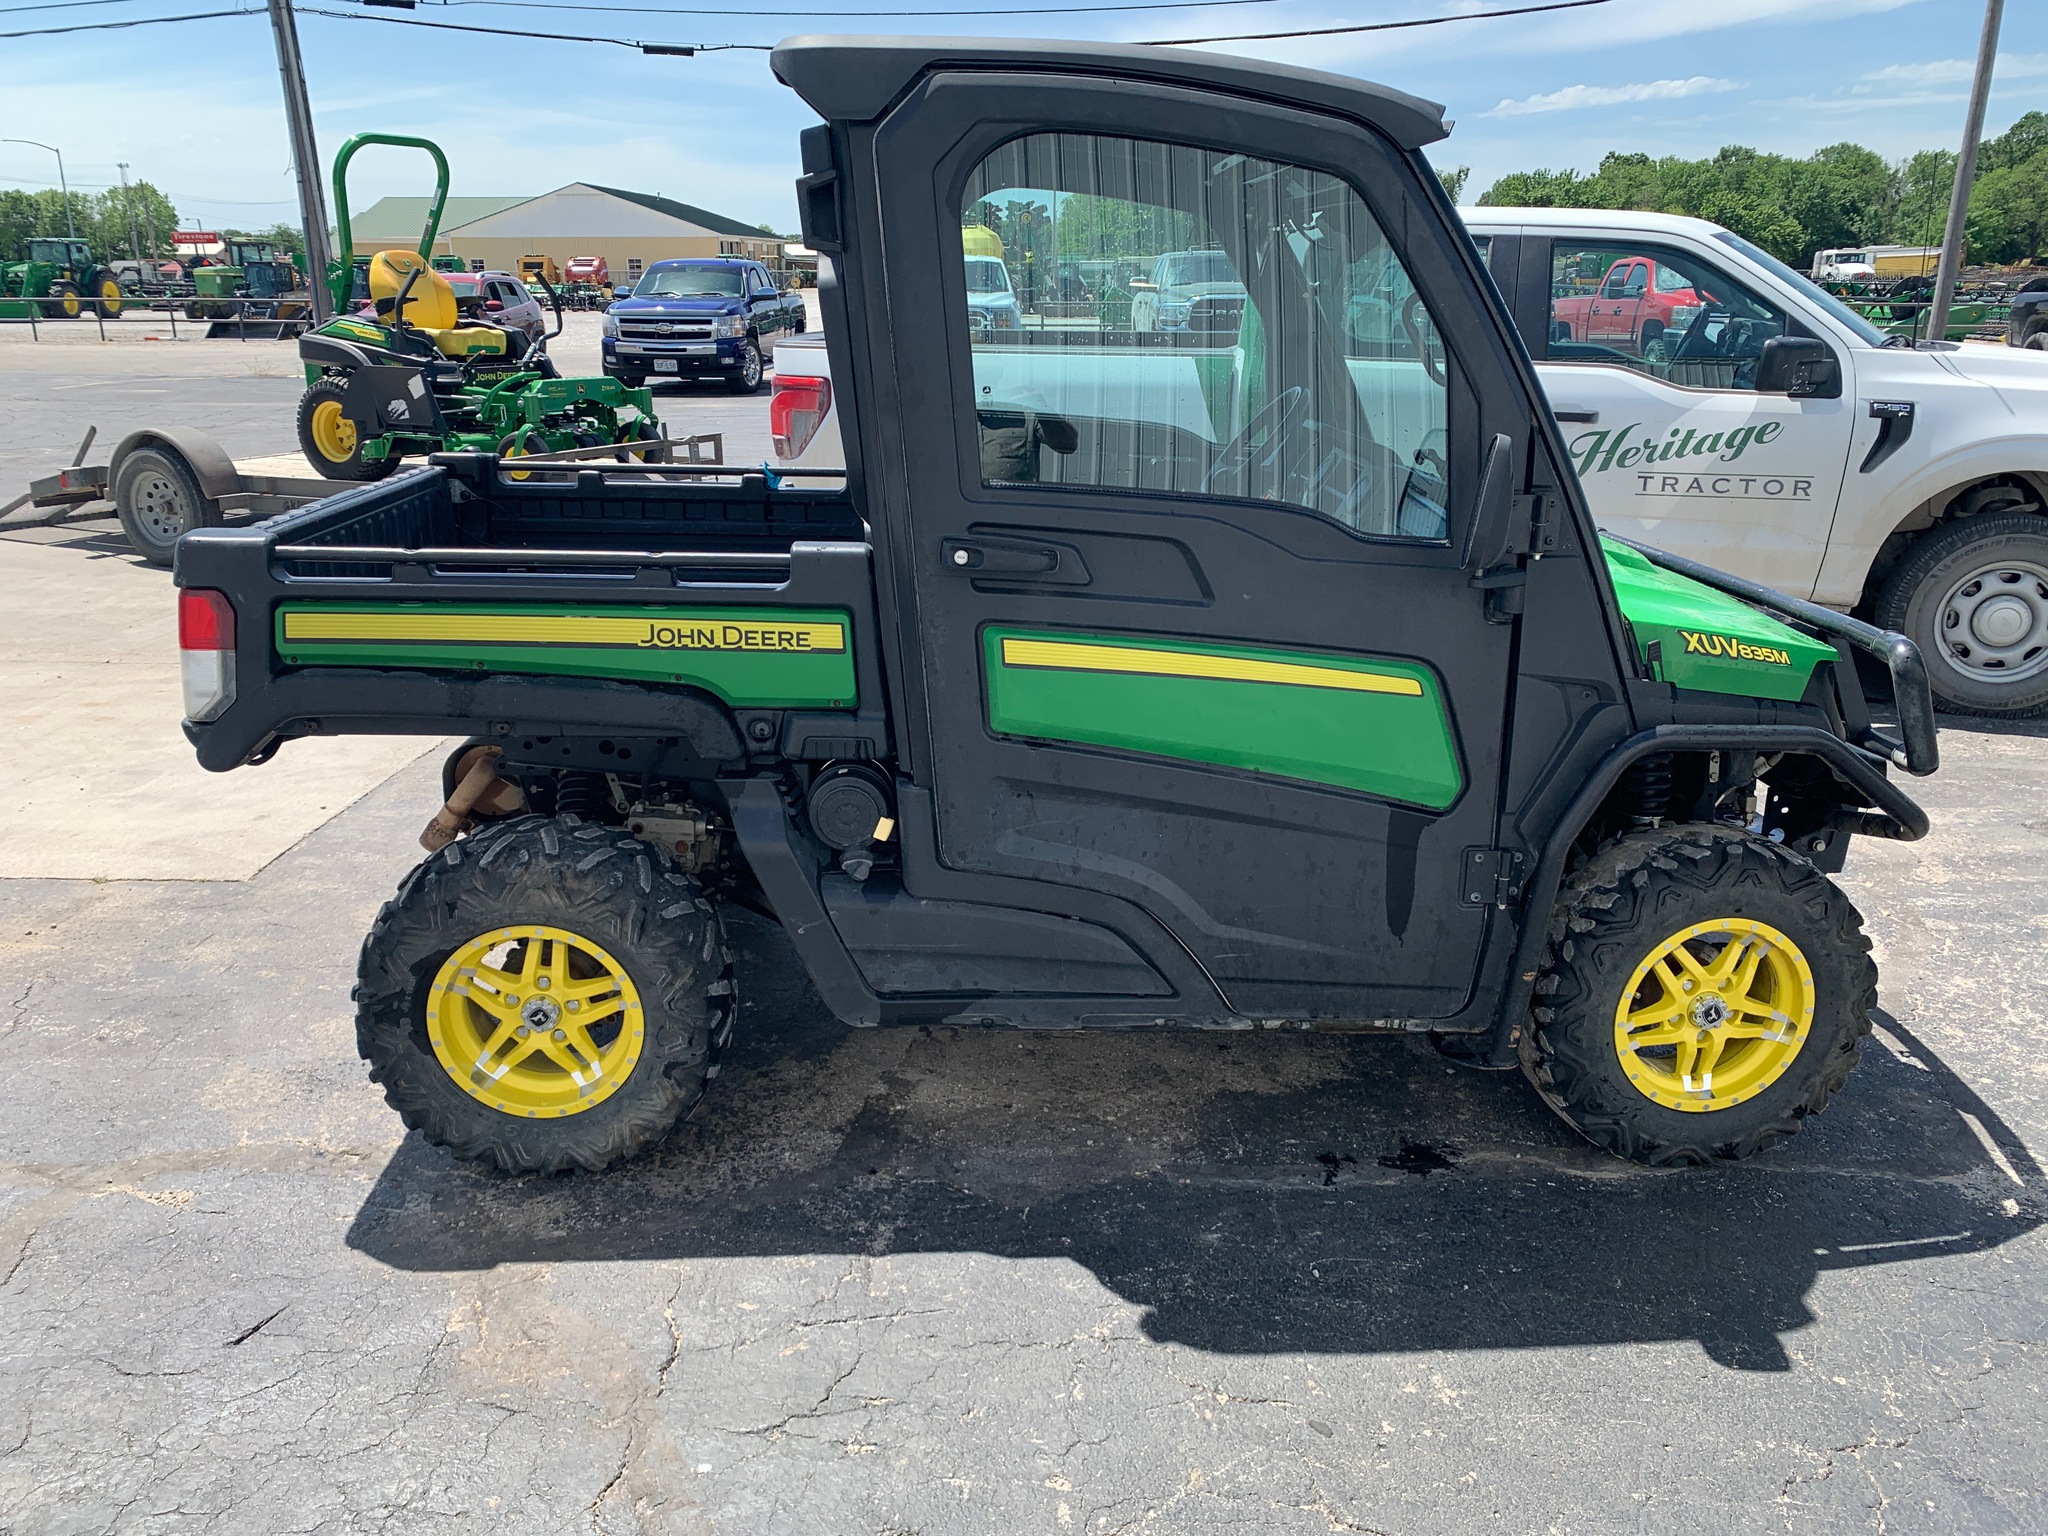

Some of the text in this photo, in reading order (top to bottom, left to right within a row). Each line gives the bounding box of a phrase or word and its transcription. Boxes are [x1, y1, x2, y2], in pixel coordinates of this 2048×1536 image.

[476, 373, 497, 381] JOHN
[1873, 403, 1911, 411] F-150
[1568, 421, 1785, 478] Heritage
[1637, 475, 1813, 496] TRACTOR
[640, 624, 812, 648] JOHN DEERE
[1680, 630, 1792, 666] XUV835M
